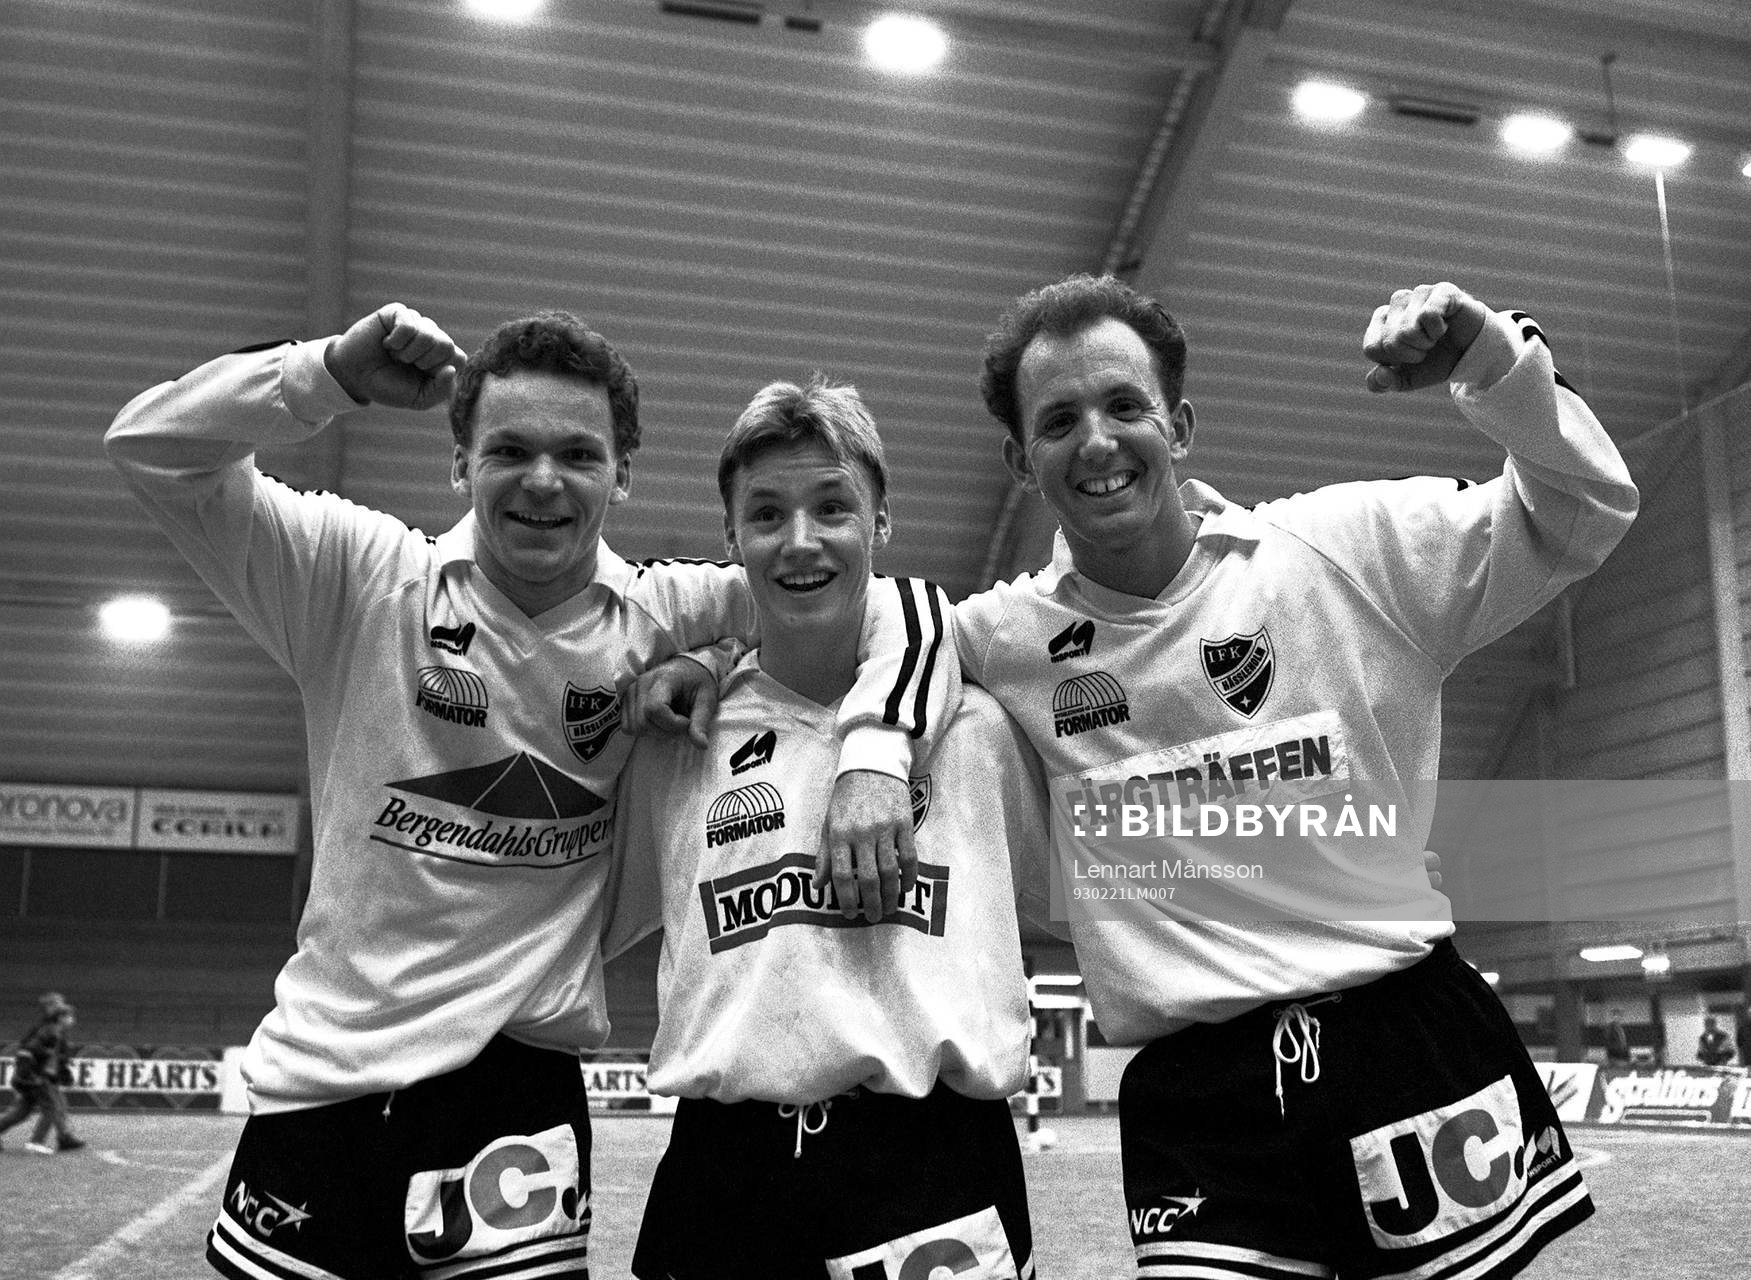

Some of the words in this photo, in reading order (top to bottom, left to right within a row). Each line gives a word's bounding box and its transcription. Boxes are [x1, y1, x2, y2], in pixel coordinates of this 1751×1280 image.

[1207, 645, 1242, 663] IFK
[569, 695, 601, 710] IFK
[1054, 703, 1131, 738] FORMATOR
[706, 811, 786, 848] FORMATOR
[718, 872, 931, 932] MODUT
[106, 1062, 218, 1089] HEARTS
[230, 1180, 279, 1237] NCC
[1130, 1207, 1180, 1235] NCC
